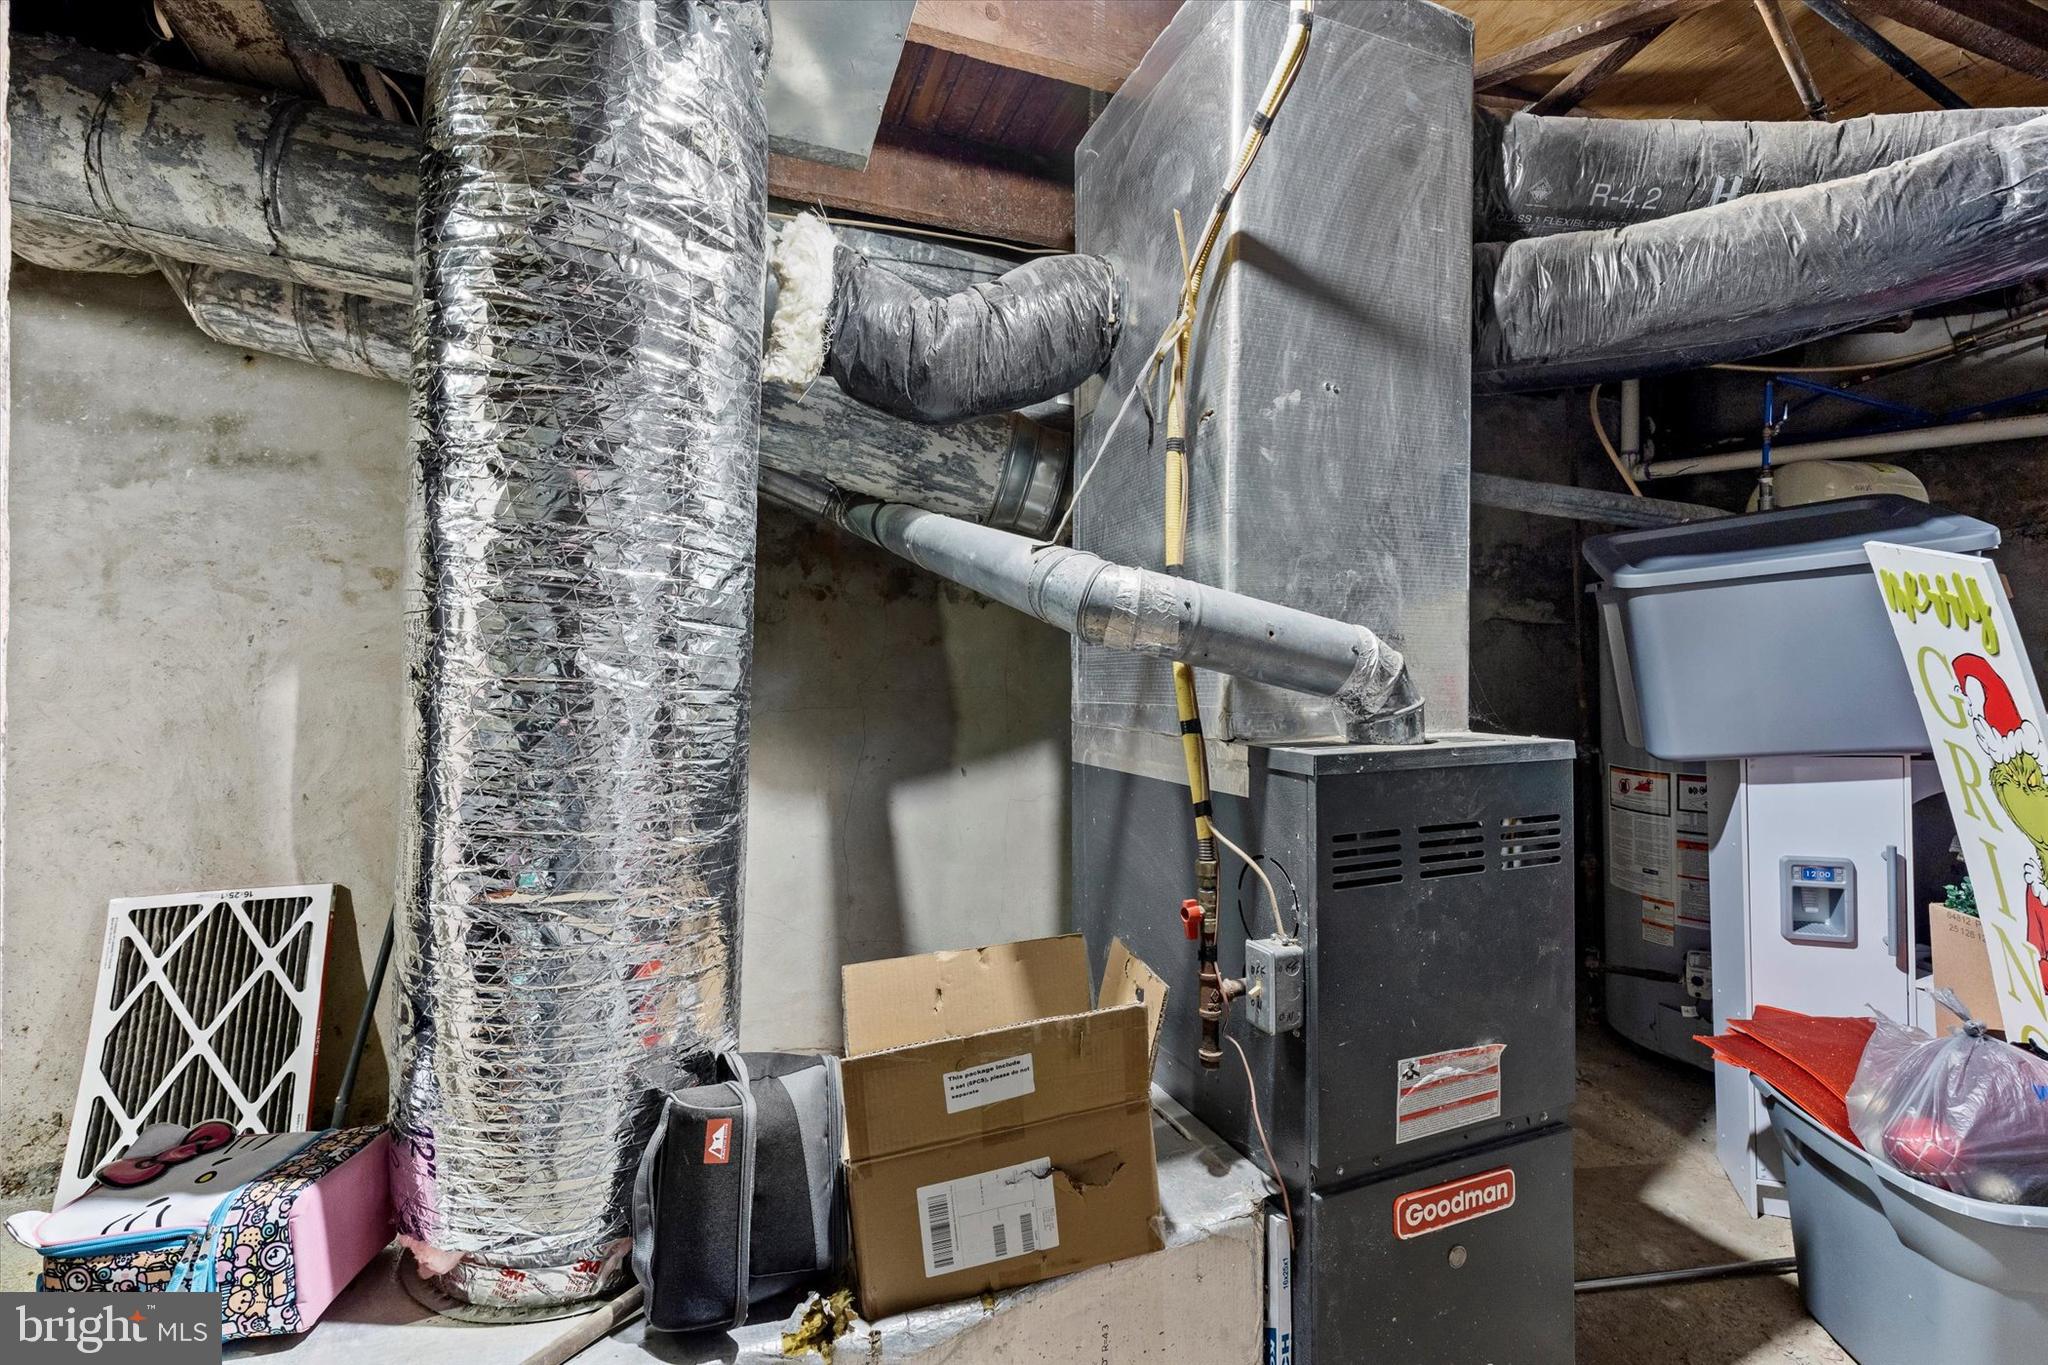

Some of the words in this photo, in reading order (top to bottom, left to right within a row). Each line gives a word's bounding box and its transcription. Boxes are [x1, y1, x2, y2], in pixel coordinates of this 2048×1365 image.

[1589, 183, 1662, 210] R-4.2
[1879, 568, 2000, 656] merry
[948, 1074, 963, 1082] This
[964, 1067, 995, 1079] package
[995, 1060, 1021, 1070] include
[955, 1082, 966, 1090] set
[990, 1072, 1010, 1082] please
[951, 1089, 979, 1099] separate
[1405, 1182, 1508, 1226] Goodman
[500, 1266, 526, 1282] 3M
[573, 1257, 601, 1274] 3M
